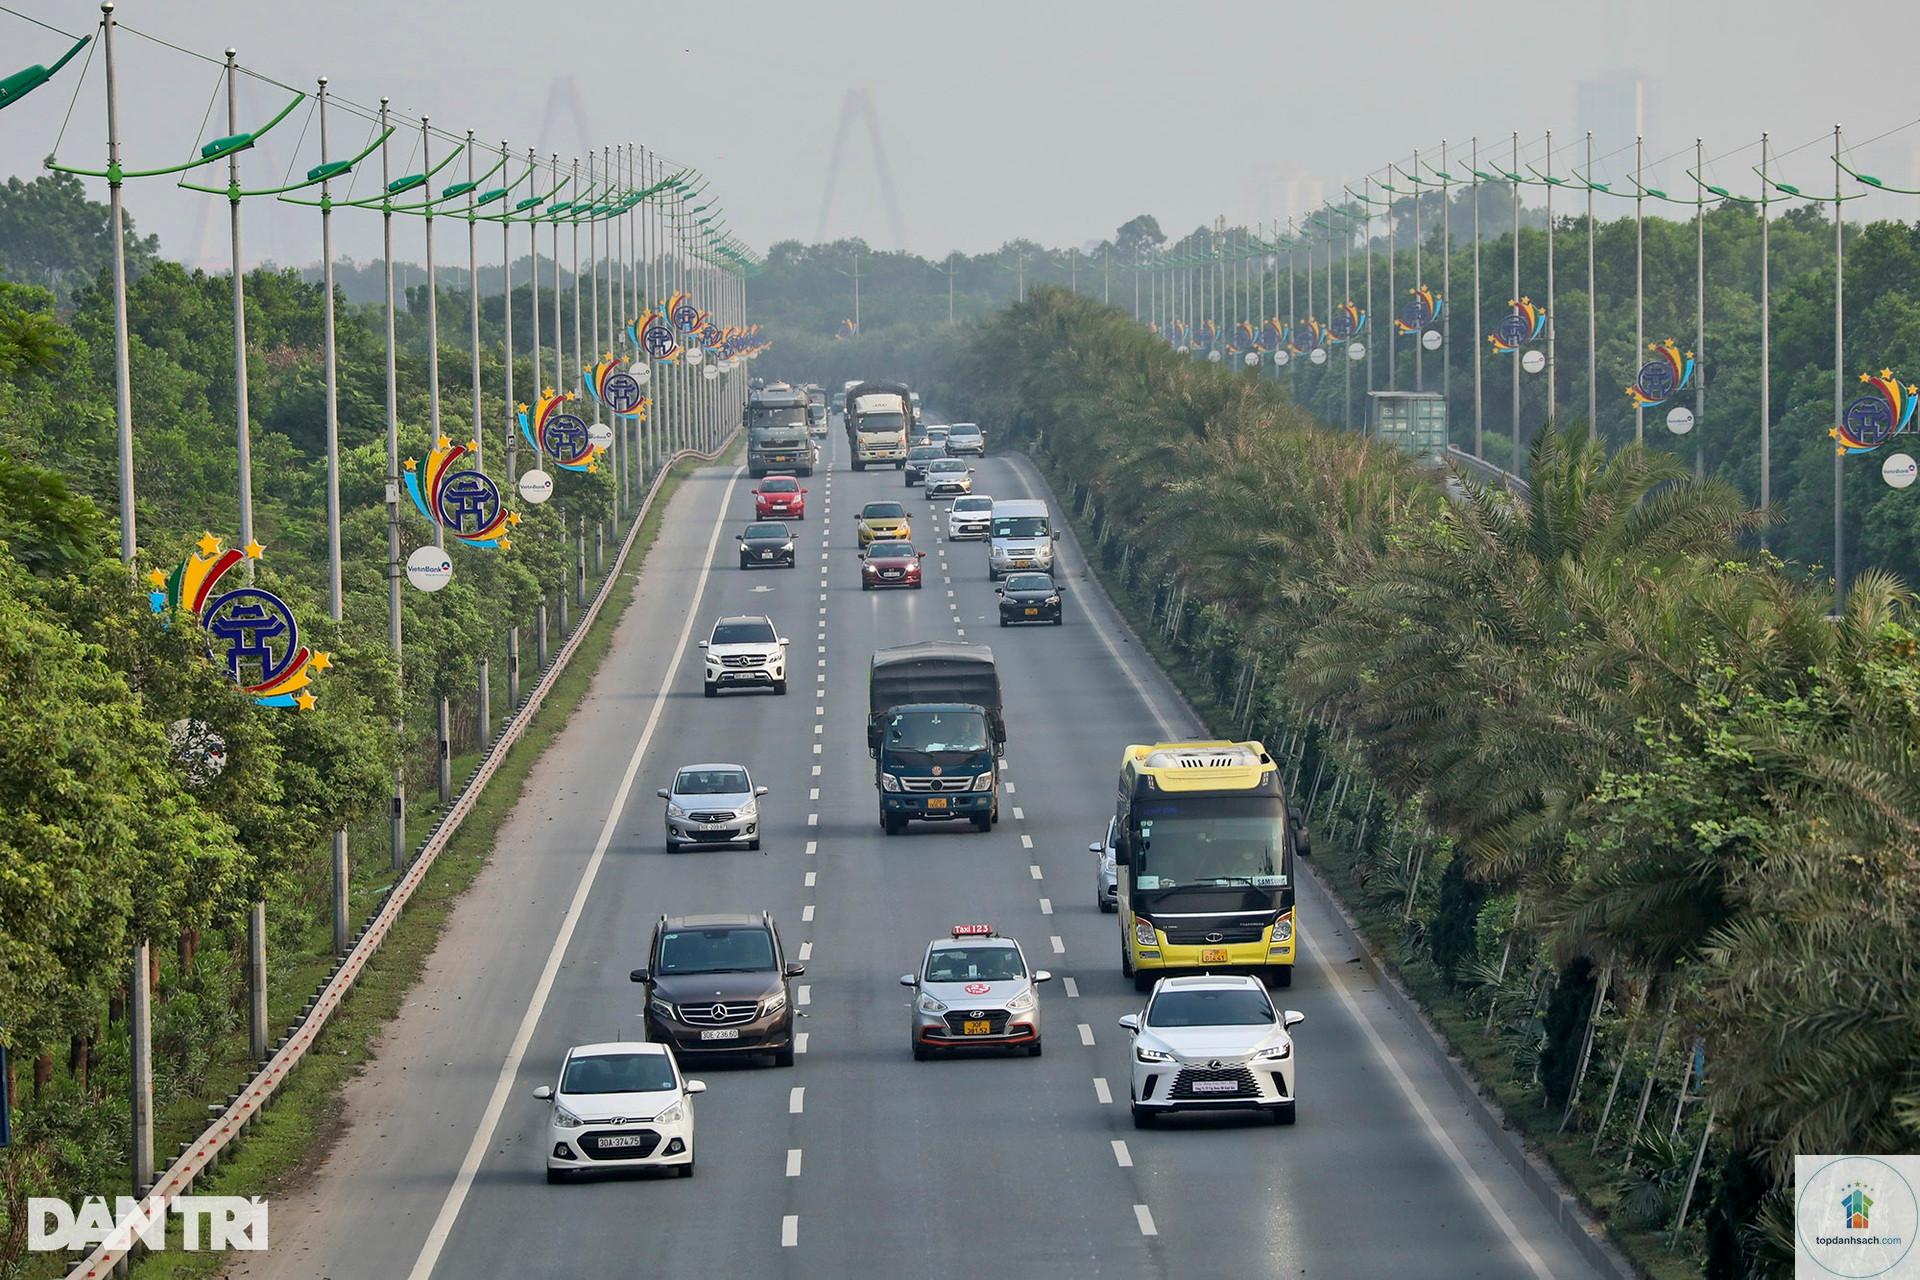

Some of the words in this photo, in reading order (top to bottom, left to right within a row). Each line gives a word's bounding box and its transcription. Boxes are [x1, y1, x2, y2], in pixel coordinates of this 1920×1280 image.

[407, 565, 442, 573] VietinBank
[954, 925, 971, 934] Taxi
[972, 924, 989, 933] 123
